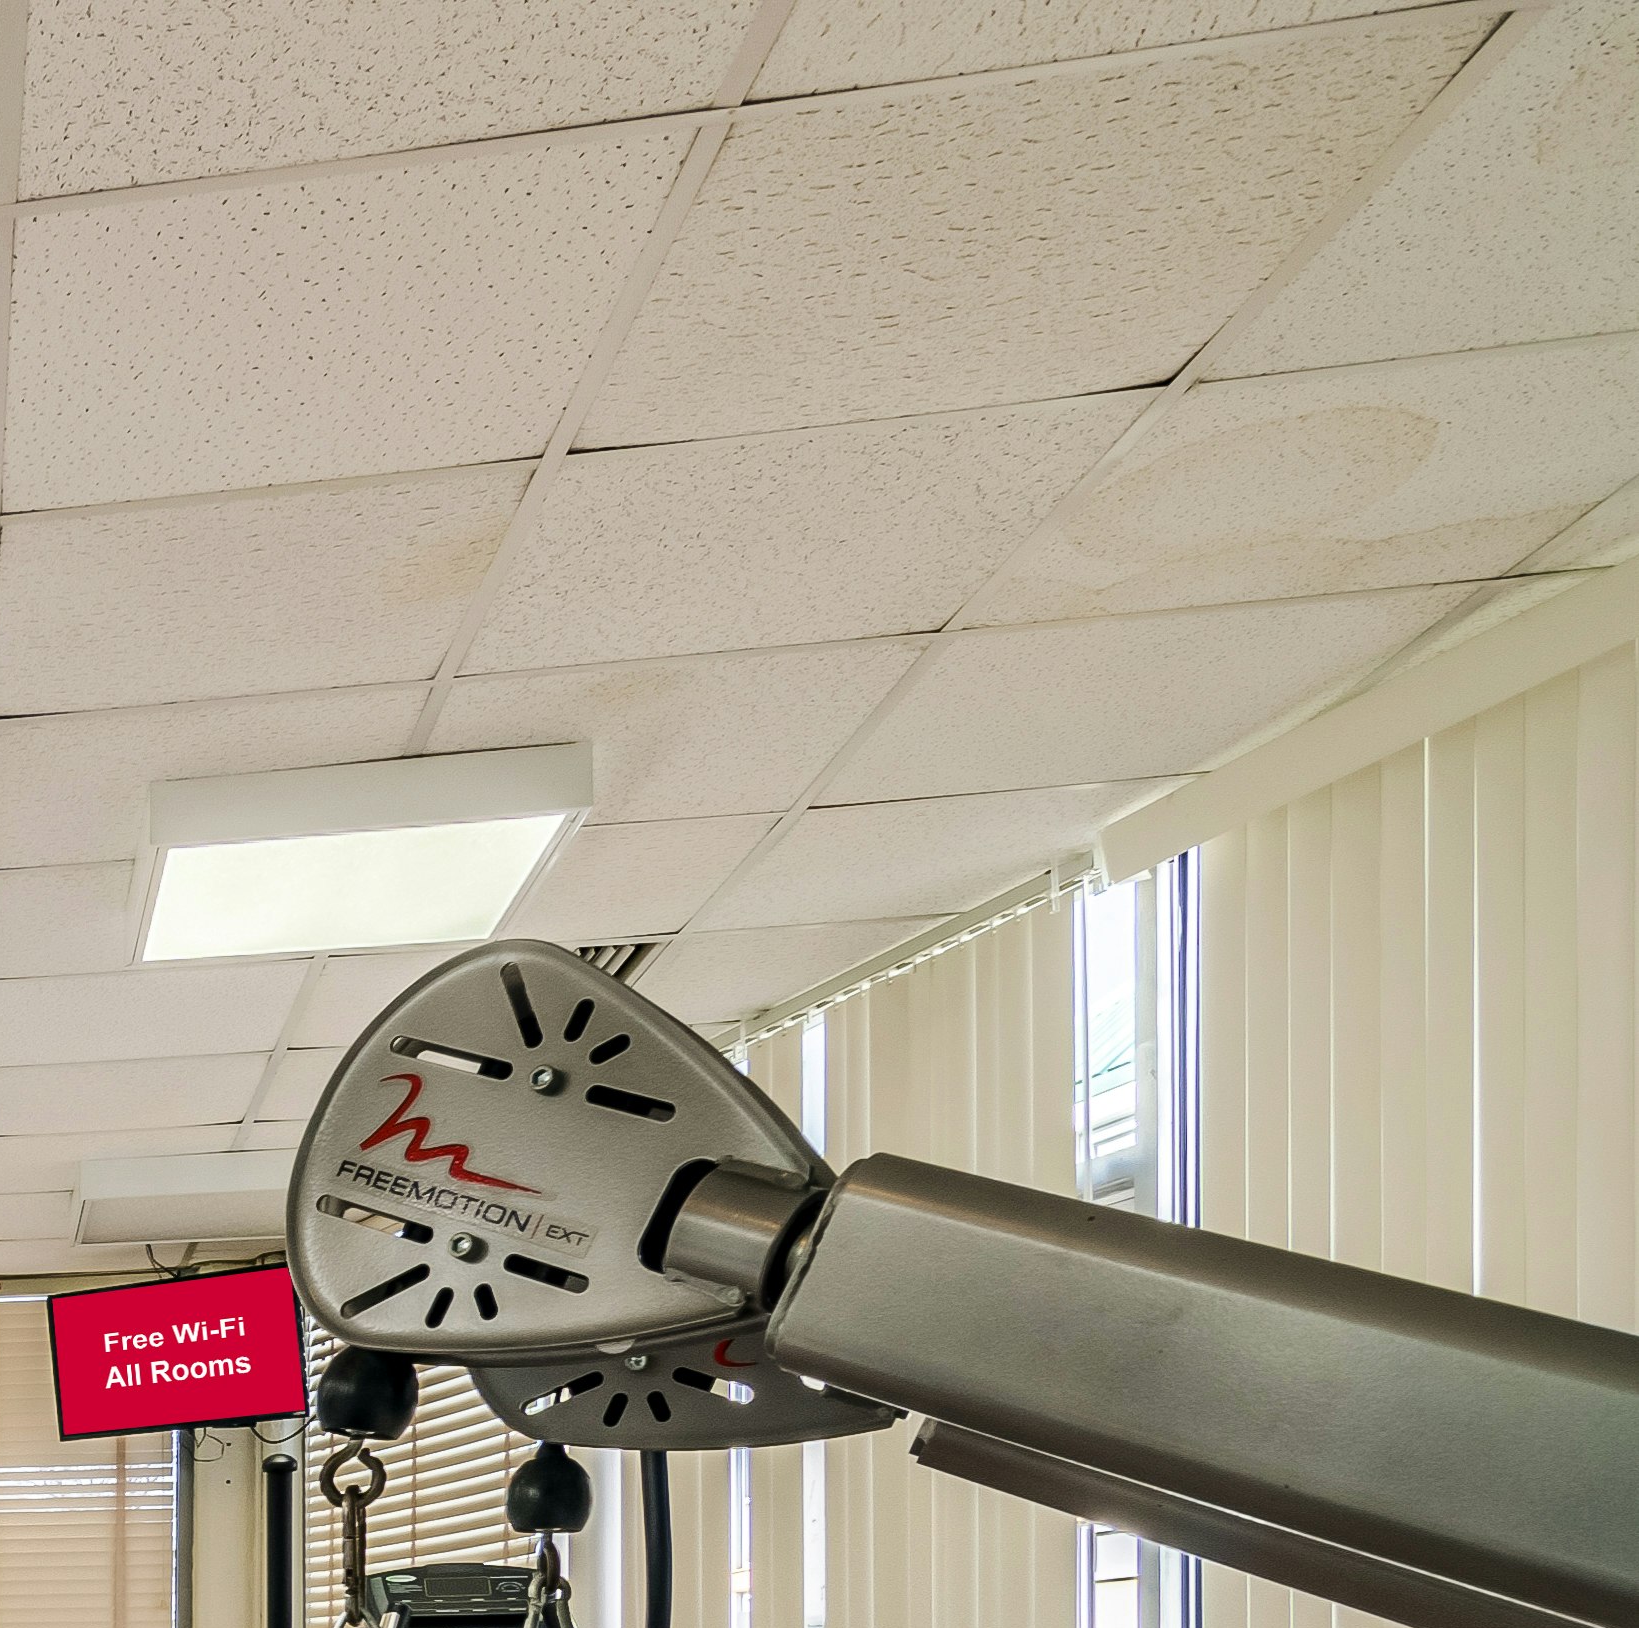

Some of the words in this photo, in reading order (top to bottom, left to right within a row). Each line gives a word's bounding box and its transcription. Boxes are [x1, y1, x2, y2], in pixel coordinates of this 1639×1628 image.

[336, 1160, 532, 1233] FREEMOTION
[546, 1224, 590, 1246] EXT
[103, 1332, 164, 1352] Free
[172, 1317, 245, 1344] Wi-Fi
[105, 1363, 141, 1389] All
[151, 1356, 251, 1383] Rooms
